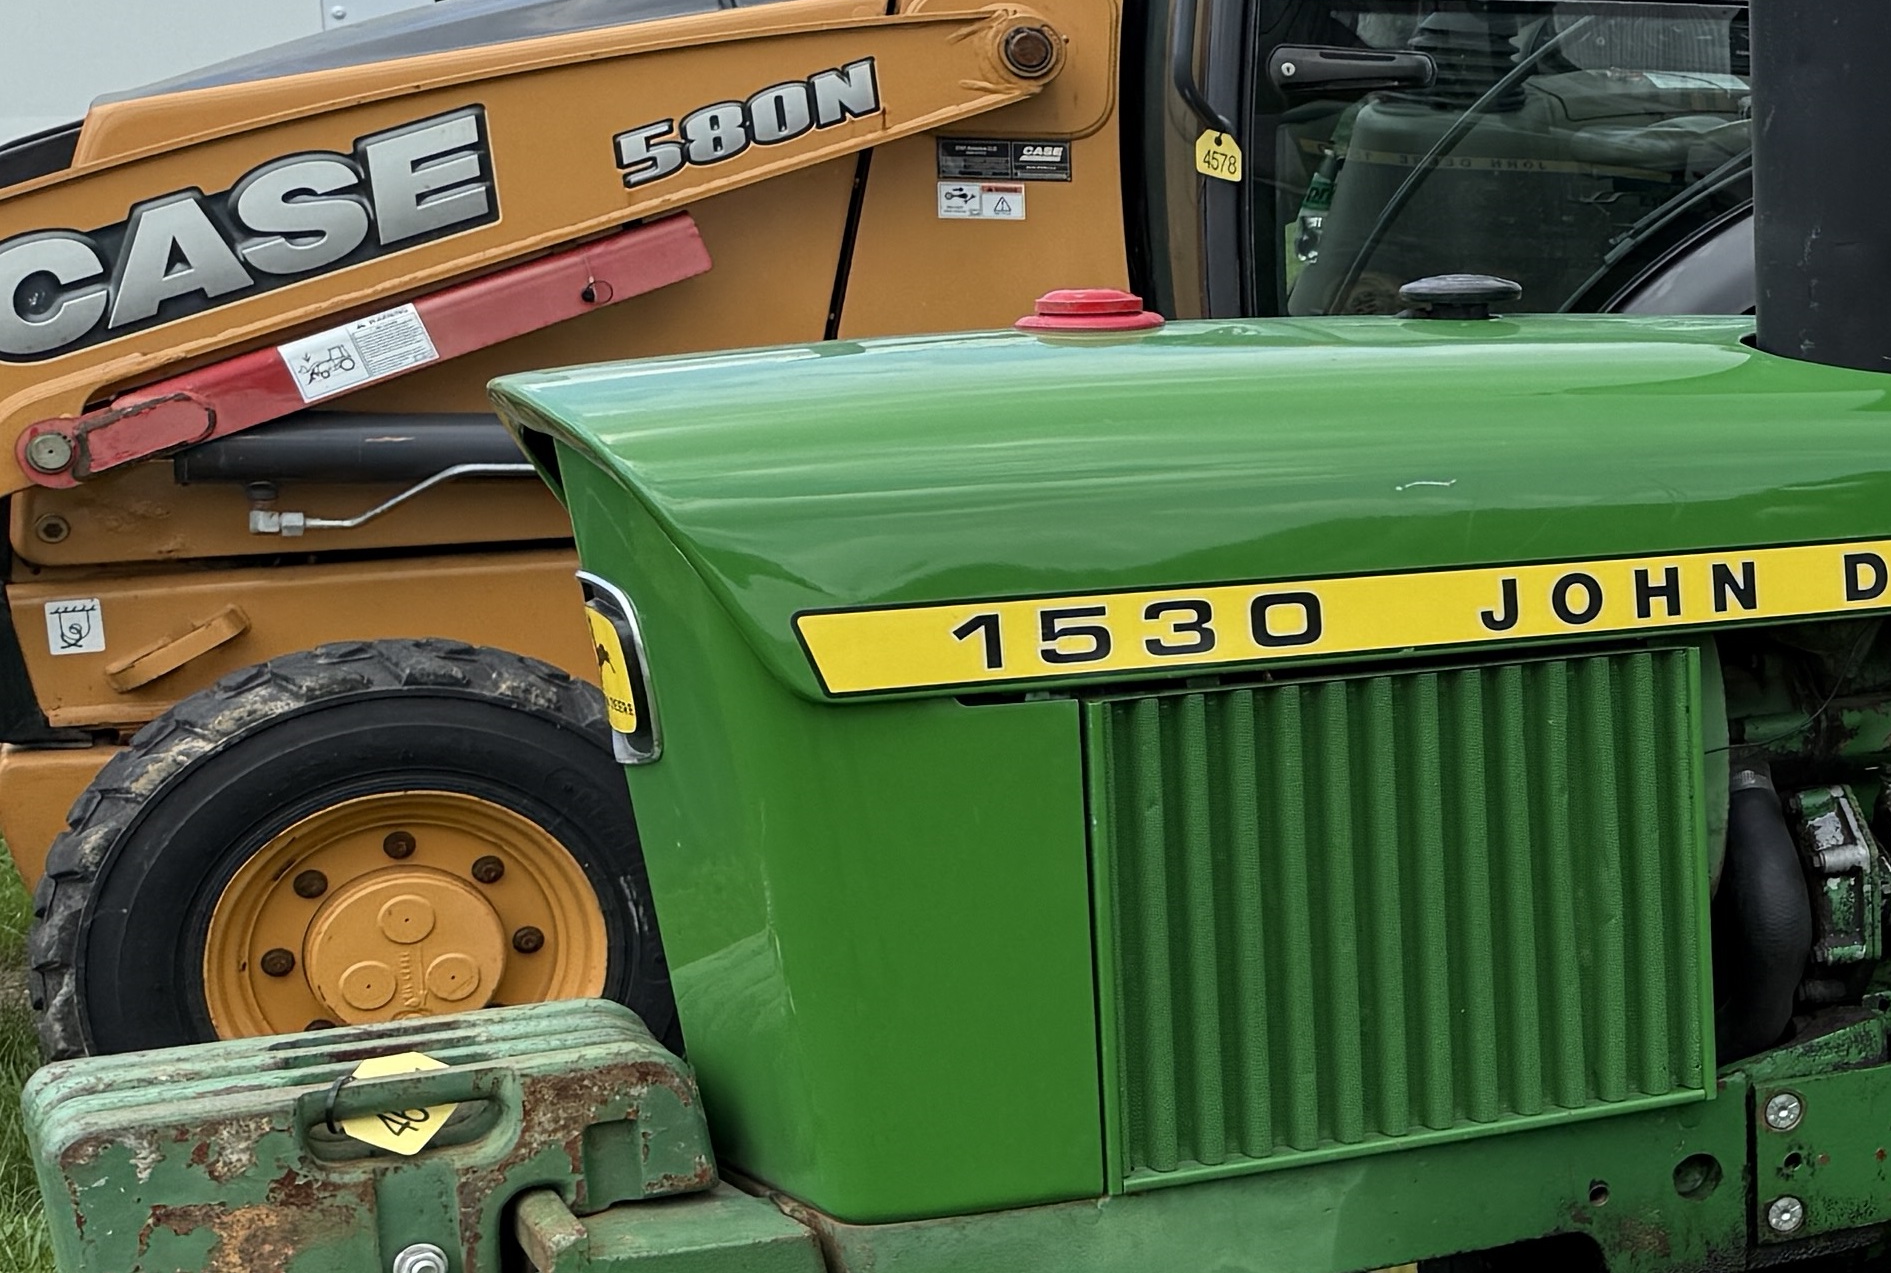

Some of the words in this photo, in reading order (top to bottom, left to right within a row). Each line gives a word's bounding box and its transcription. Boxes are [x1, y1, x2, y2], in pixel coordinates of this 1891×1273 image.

[614, 56, 882, 188] 580N
[1022, 146, 1064, 156] CASE
[1203, 149, 1237, 175] 4578
[0, 103, 497, 360] CASE
[952, 591, 1324, 672] 1530
[1481, 560, 1759, 632] JOHN
